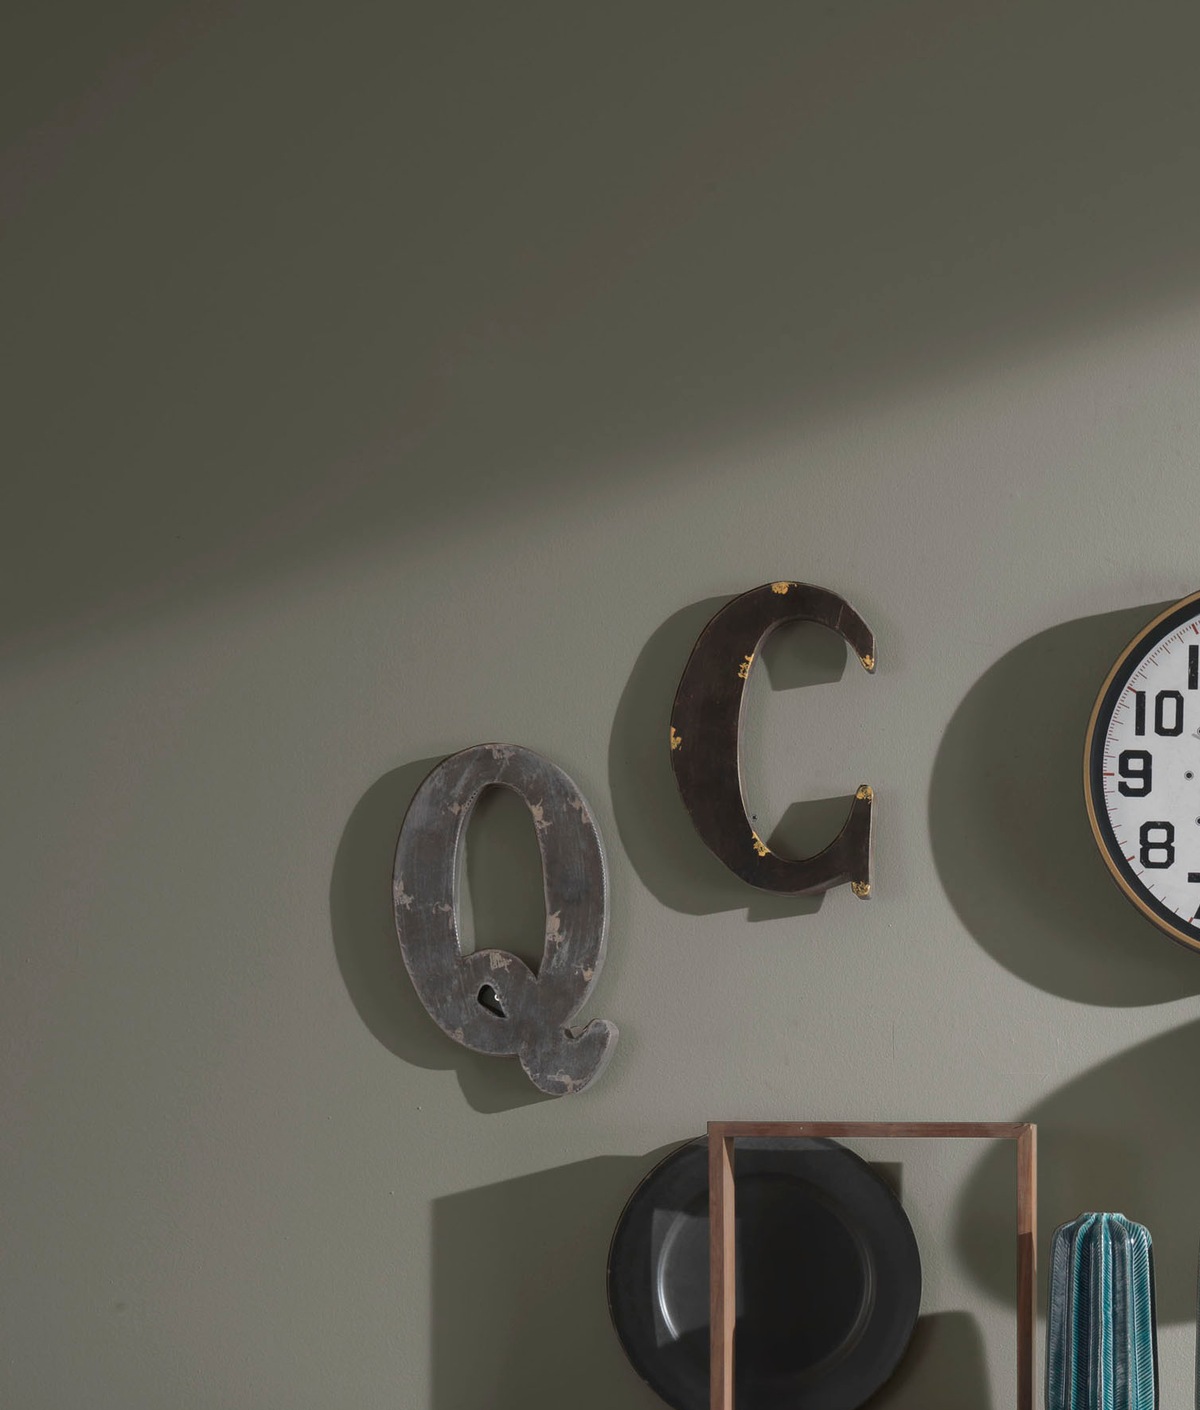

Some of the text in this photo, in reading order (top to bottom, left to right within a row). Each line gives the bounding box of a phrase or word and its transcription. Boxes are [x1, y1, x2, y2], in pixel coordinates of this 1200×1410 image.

[1135, 690, 1184, 736] 10
[1118, 750, 1152, 797] 9
[1140, 821, 1175, 869] 8
[393, 742, 619, 1096] Q
